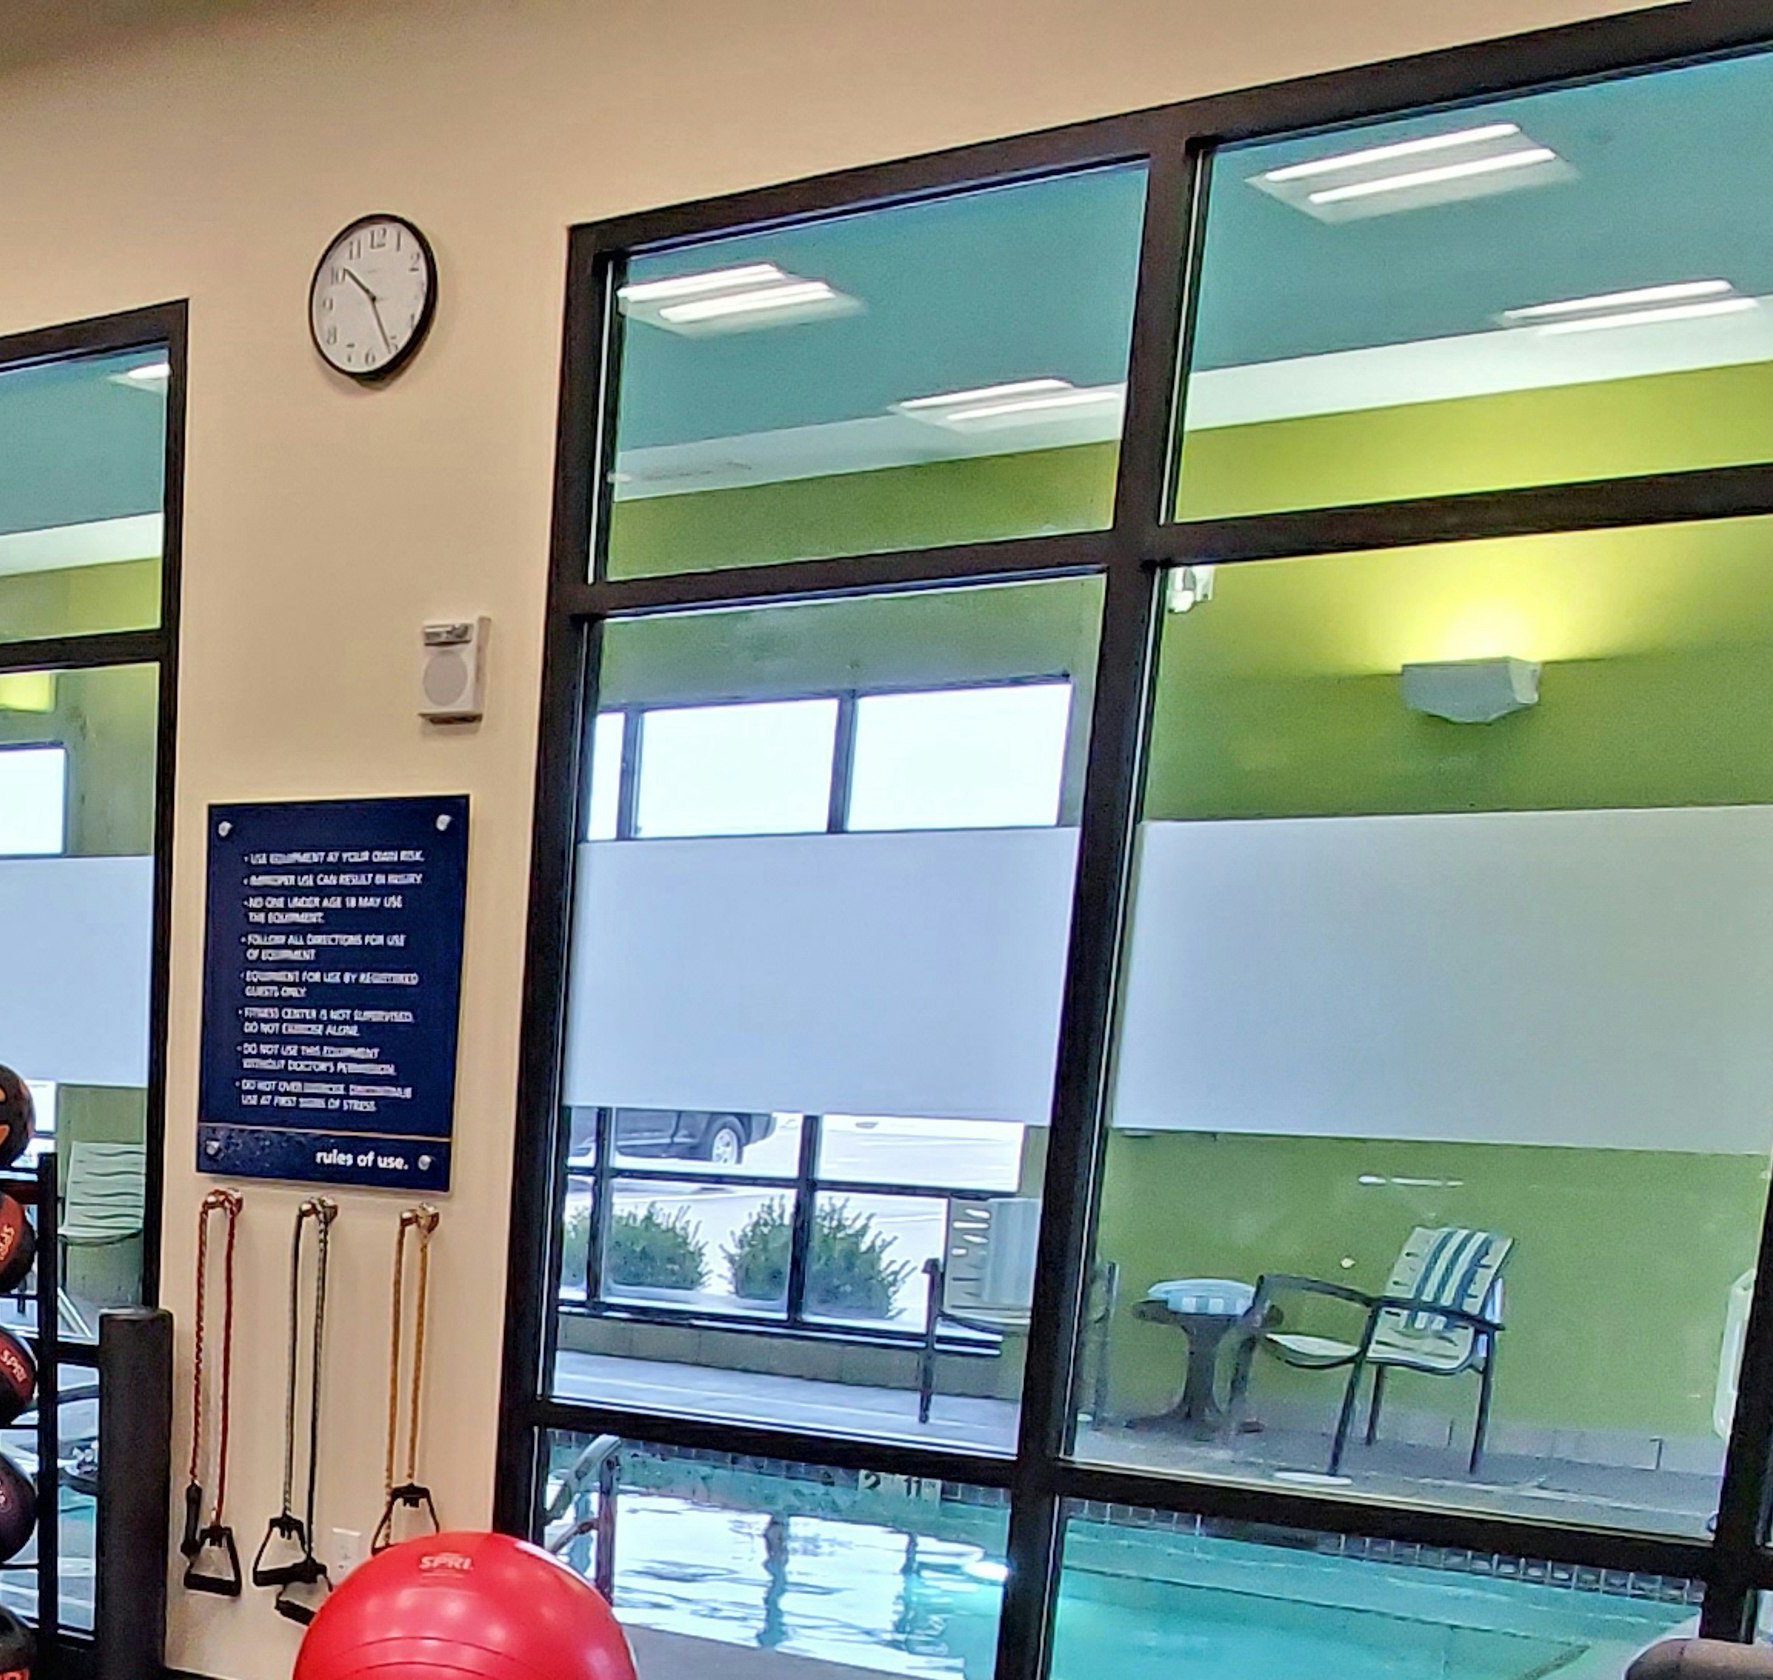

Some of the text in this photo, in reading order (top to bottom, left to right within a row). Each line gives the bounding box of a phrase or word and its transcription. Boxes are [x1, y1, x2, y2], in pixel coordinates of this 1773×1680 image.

[370, 227, 387, 249] 12
[409, 252, 421, 272] 2
[315, 1149, 408, 1170] rules of use.
[0, 1350, 26, 1382] SPRI
[419, 1552, 473, 1571] SPRI
